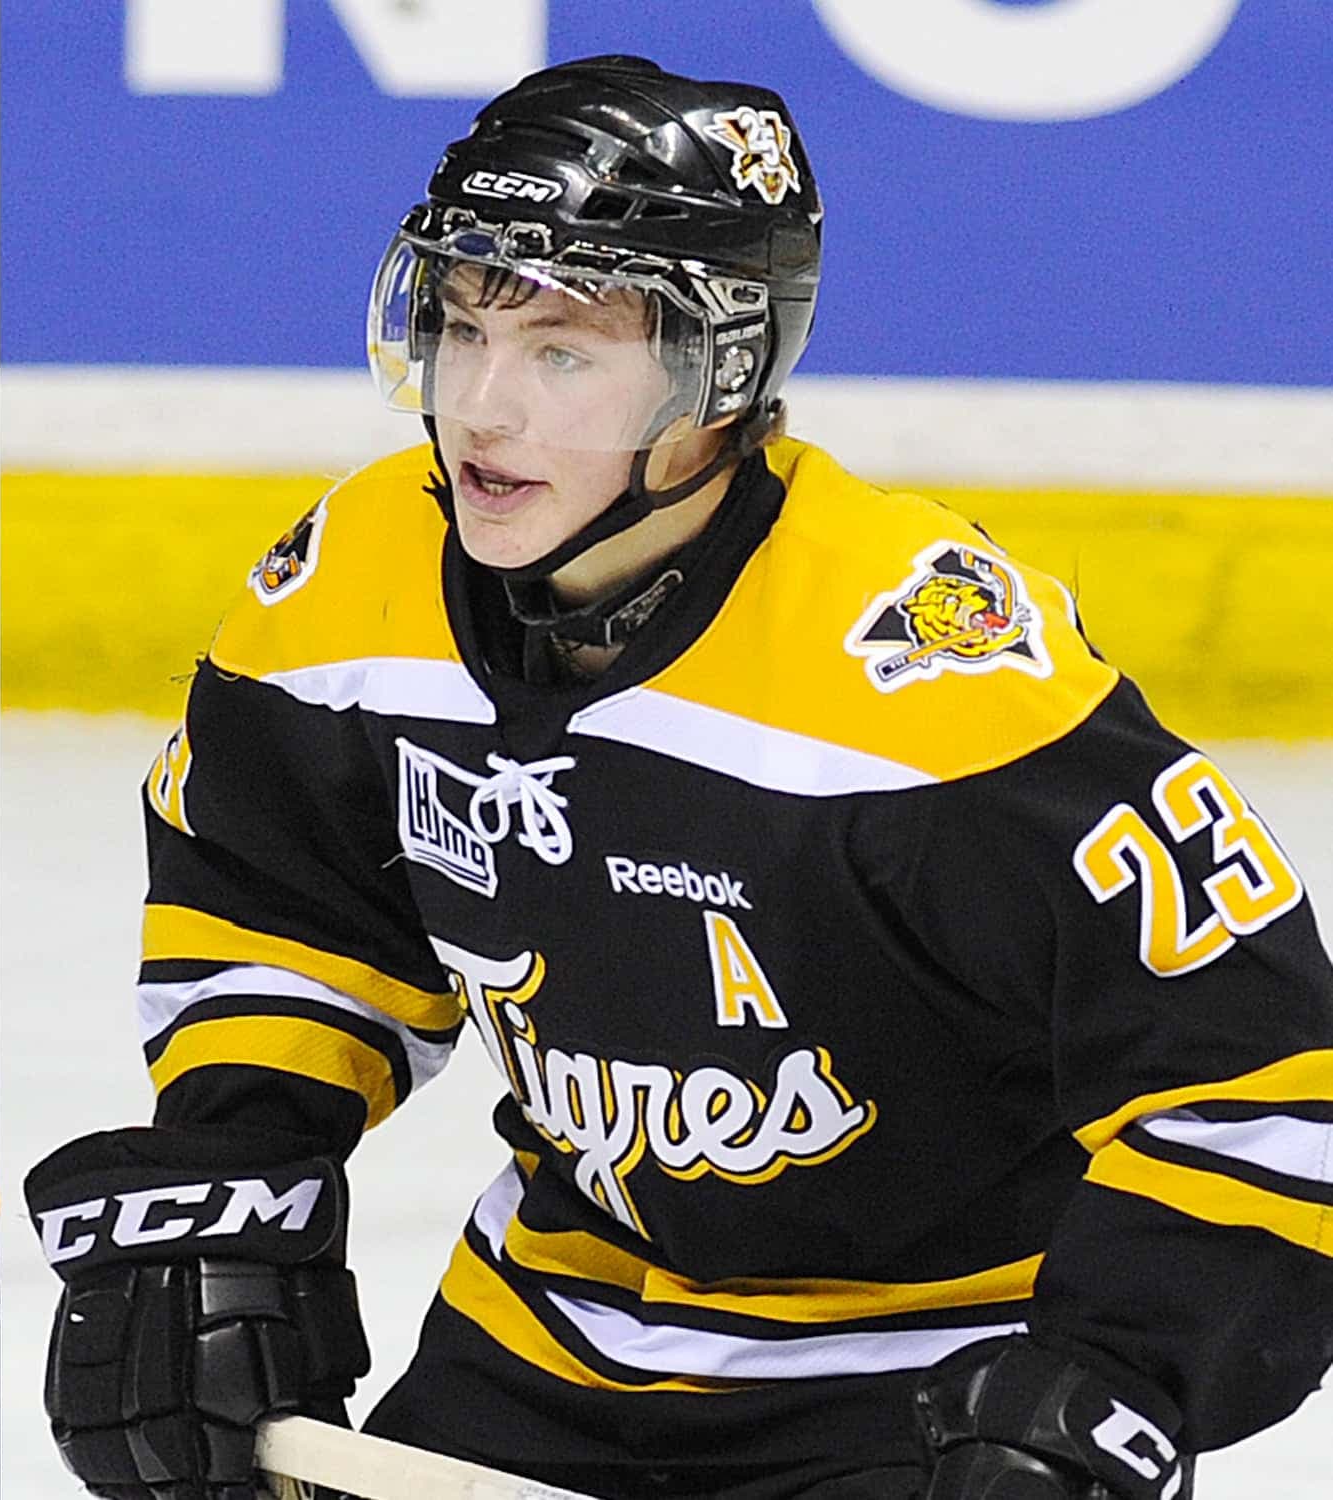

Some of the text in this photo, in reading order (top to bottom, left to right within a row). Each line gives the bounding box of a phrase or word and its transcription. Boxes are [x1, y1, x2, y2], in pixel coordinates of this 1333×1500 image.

[470, 170, 552, 203] CCM
[605, 855, 753, 910] Reebok
[1073, 751, 1304, 978] 23
[704, 910, 789, 1028] A
[428, 934, 879, 1242] Tigres
[36, 1178, 323, 1264] CCM
